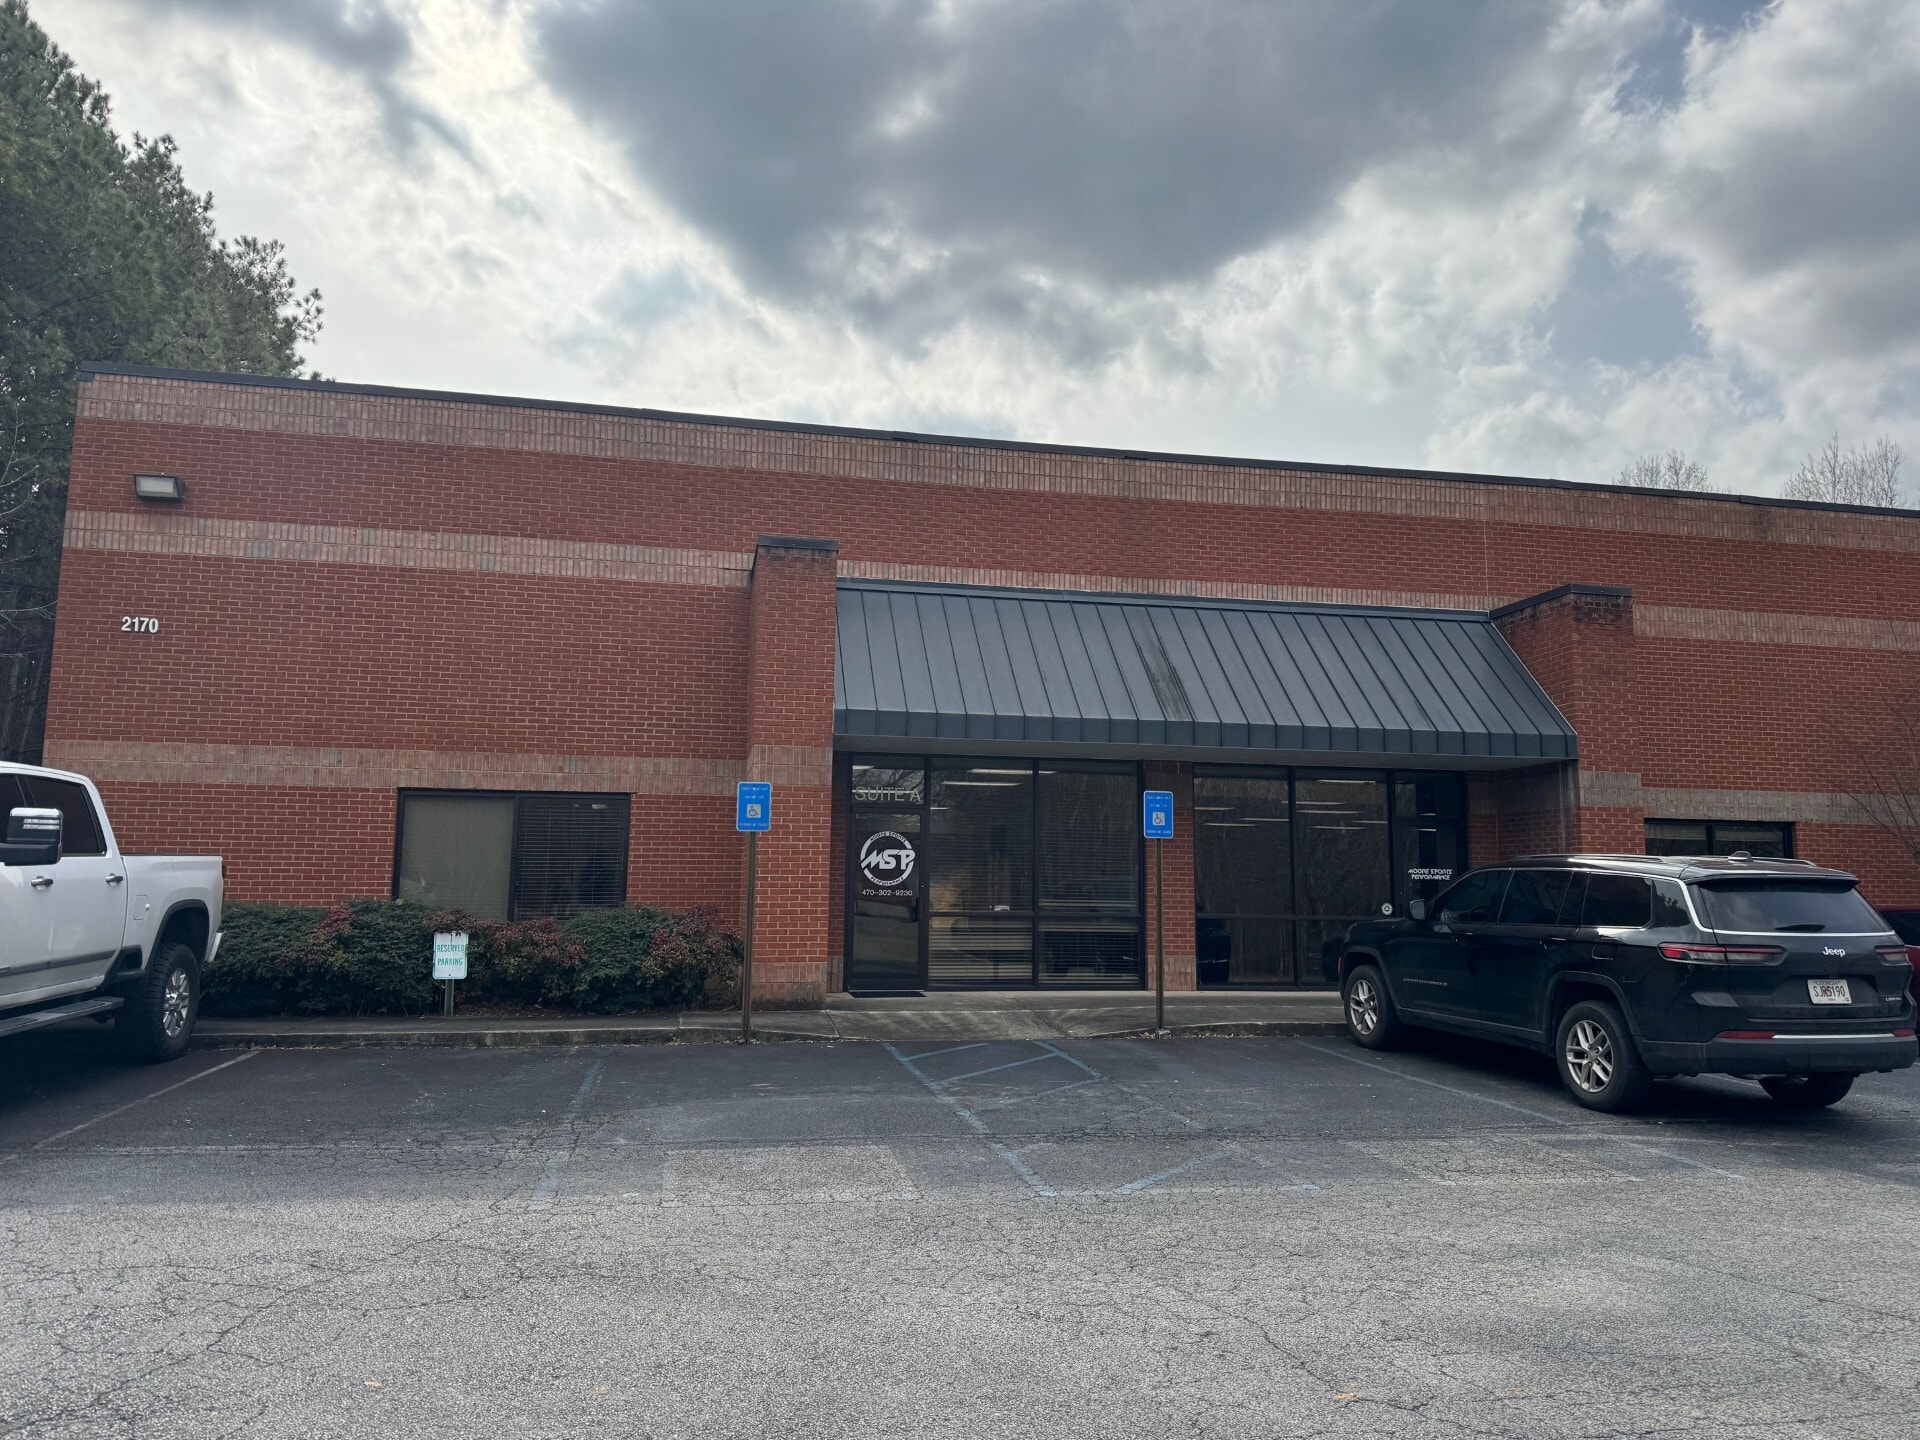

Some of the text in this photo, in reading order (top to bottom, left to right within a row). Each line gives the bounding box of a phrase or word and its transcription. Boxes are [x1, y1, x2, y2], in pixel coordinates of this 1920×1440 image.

[121, 616, 159, 633] 2170
[854, 786, 921, 802] SUITE A
[860, 848, 916, 870] MSP
[861, 889, 913, 897] 470-302-9230
[436, 944, 465, 952] RESERVED
[1822, 946, 1846, 957] Jeep
[437, 957, 463, 966] PARKING
